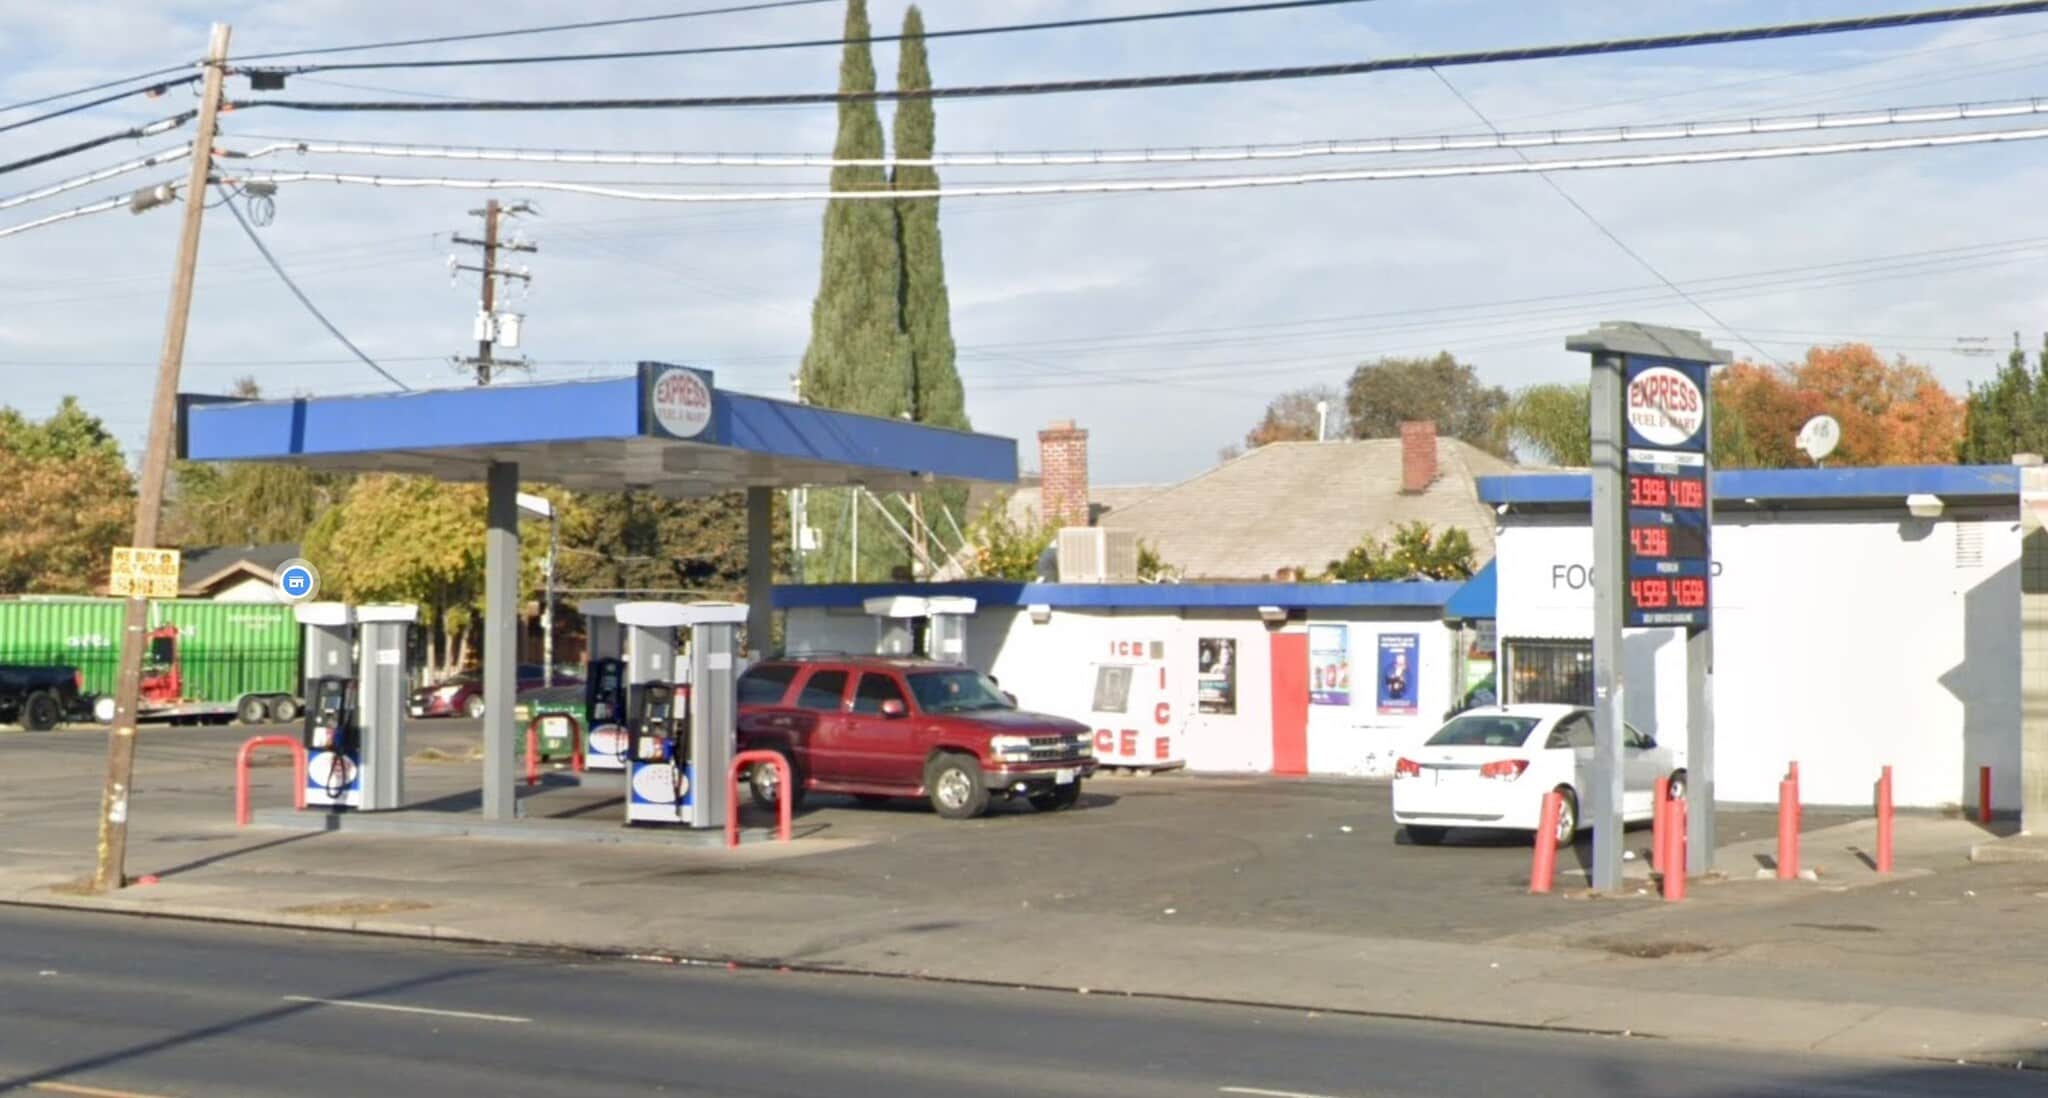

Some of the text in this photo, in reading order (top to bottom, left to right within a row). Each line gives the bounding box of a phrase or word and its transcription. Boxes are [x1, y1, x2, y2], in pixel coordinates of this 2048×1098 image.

[657, 375, 706, 408] EXPRESS
[1631, 375, 1697, 412] EXPRESS
[1632, 412, 1657, 426] FUEL
[1669, 416, 1696, 430] MART
[135, 551, 157, 562] BUY
[1110, 640, 1143, 657] ICE
[1093, 729, 1138, 756] CE
